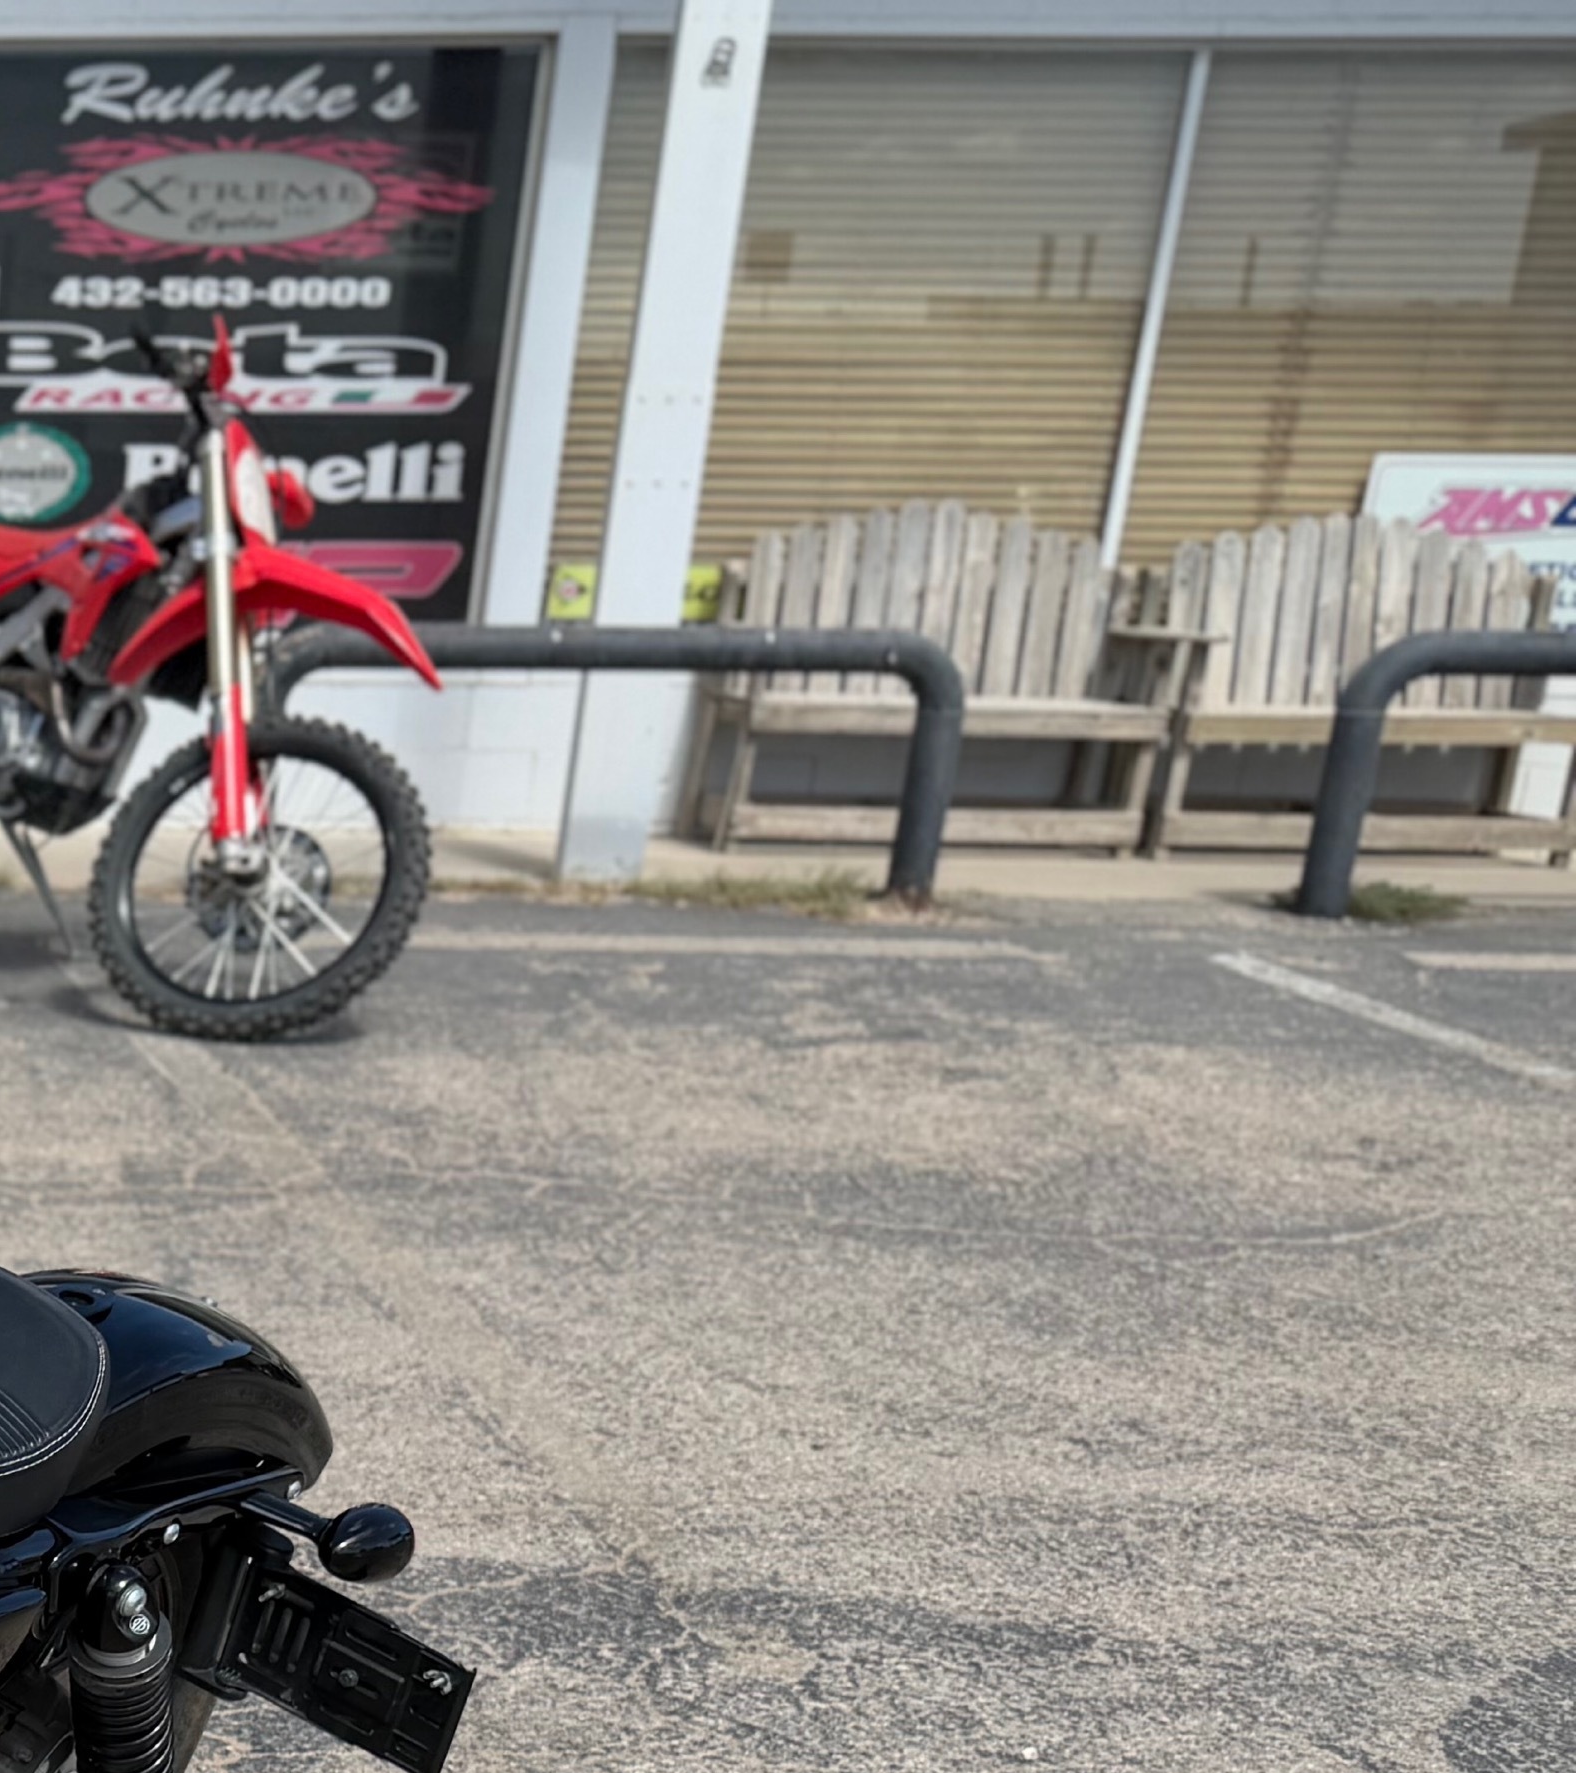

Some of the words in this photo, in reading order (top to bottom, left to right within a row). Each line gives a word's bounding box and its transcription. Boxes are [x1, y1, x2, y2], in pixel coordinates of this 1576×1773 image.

[61, 61, 419, 125] Ruhnke's
[111, 174, 365, 216] XTREME
[53, 276, 391, 309] 432-563-0000
[27, 387, 315, 406] RACNG
